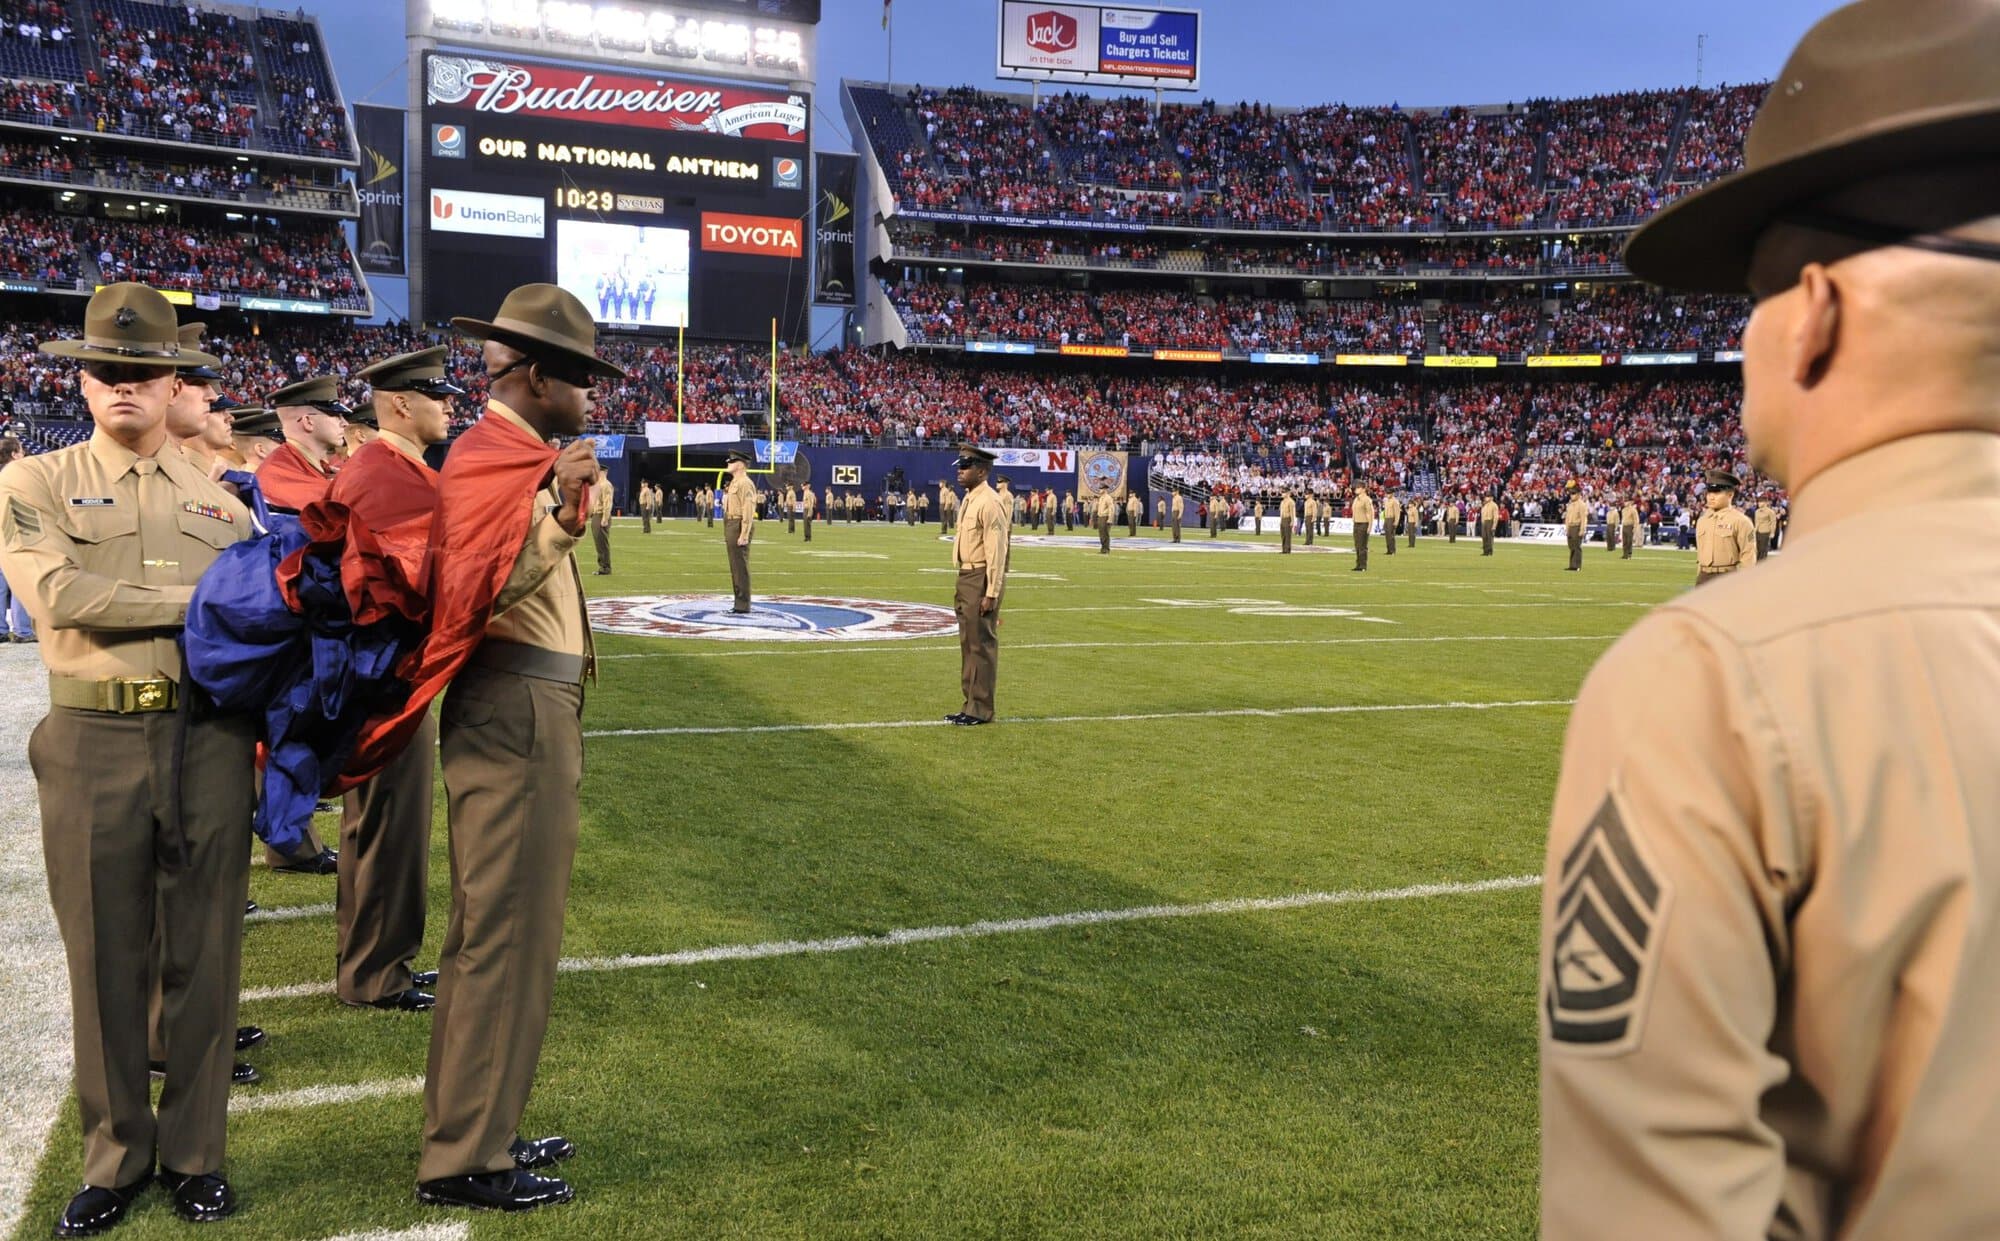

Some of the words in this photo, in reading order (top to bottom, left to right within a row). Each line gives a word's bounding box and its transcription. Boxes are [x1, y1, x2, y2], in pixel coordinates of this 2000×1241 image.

[1028, 16, 1075, 48] Jack
[1119, 31, 1137, 46] Buy
[1139, 33, 1157, 45] and
[1159, 33, 1177, 46] Sell
[1029, 55, 1037, 63] in
[1039, 56, 1054, 64] the
[1056, 57, 1073, 65] box
[1106, 44, 1150, 60] Chargers
[1152, 48, 1190, 61] Tickets!
[463, 70, 722, 113] Budweiser
[724, 109, 772, 128] American
[774, 108, 804, 123] Lager
[478, 137, 528, 159] OUR
[537, 142, 656, 170] NATIONAL
[666, 156, 759, 181] ANTHEM
[358, 189, 402, 206] Sprint
[556, 188, 614, 211] 10:29
[618, 198, 664, 210] SYCUAN
[460, 206, 542, 225] UnionBank
[1064, 220, 1092, 228] LOCATION
[706, 223, 798, 248] TOYOTA
[817, 228, 854, 244] Sprint
[1062, 346, 1094, 355] WELLS
[1096, 347, 1127, 356] FARGO
[1047, 452, 1068, 470] N
[836, 468, 858, 482] 25
